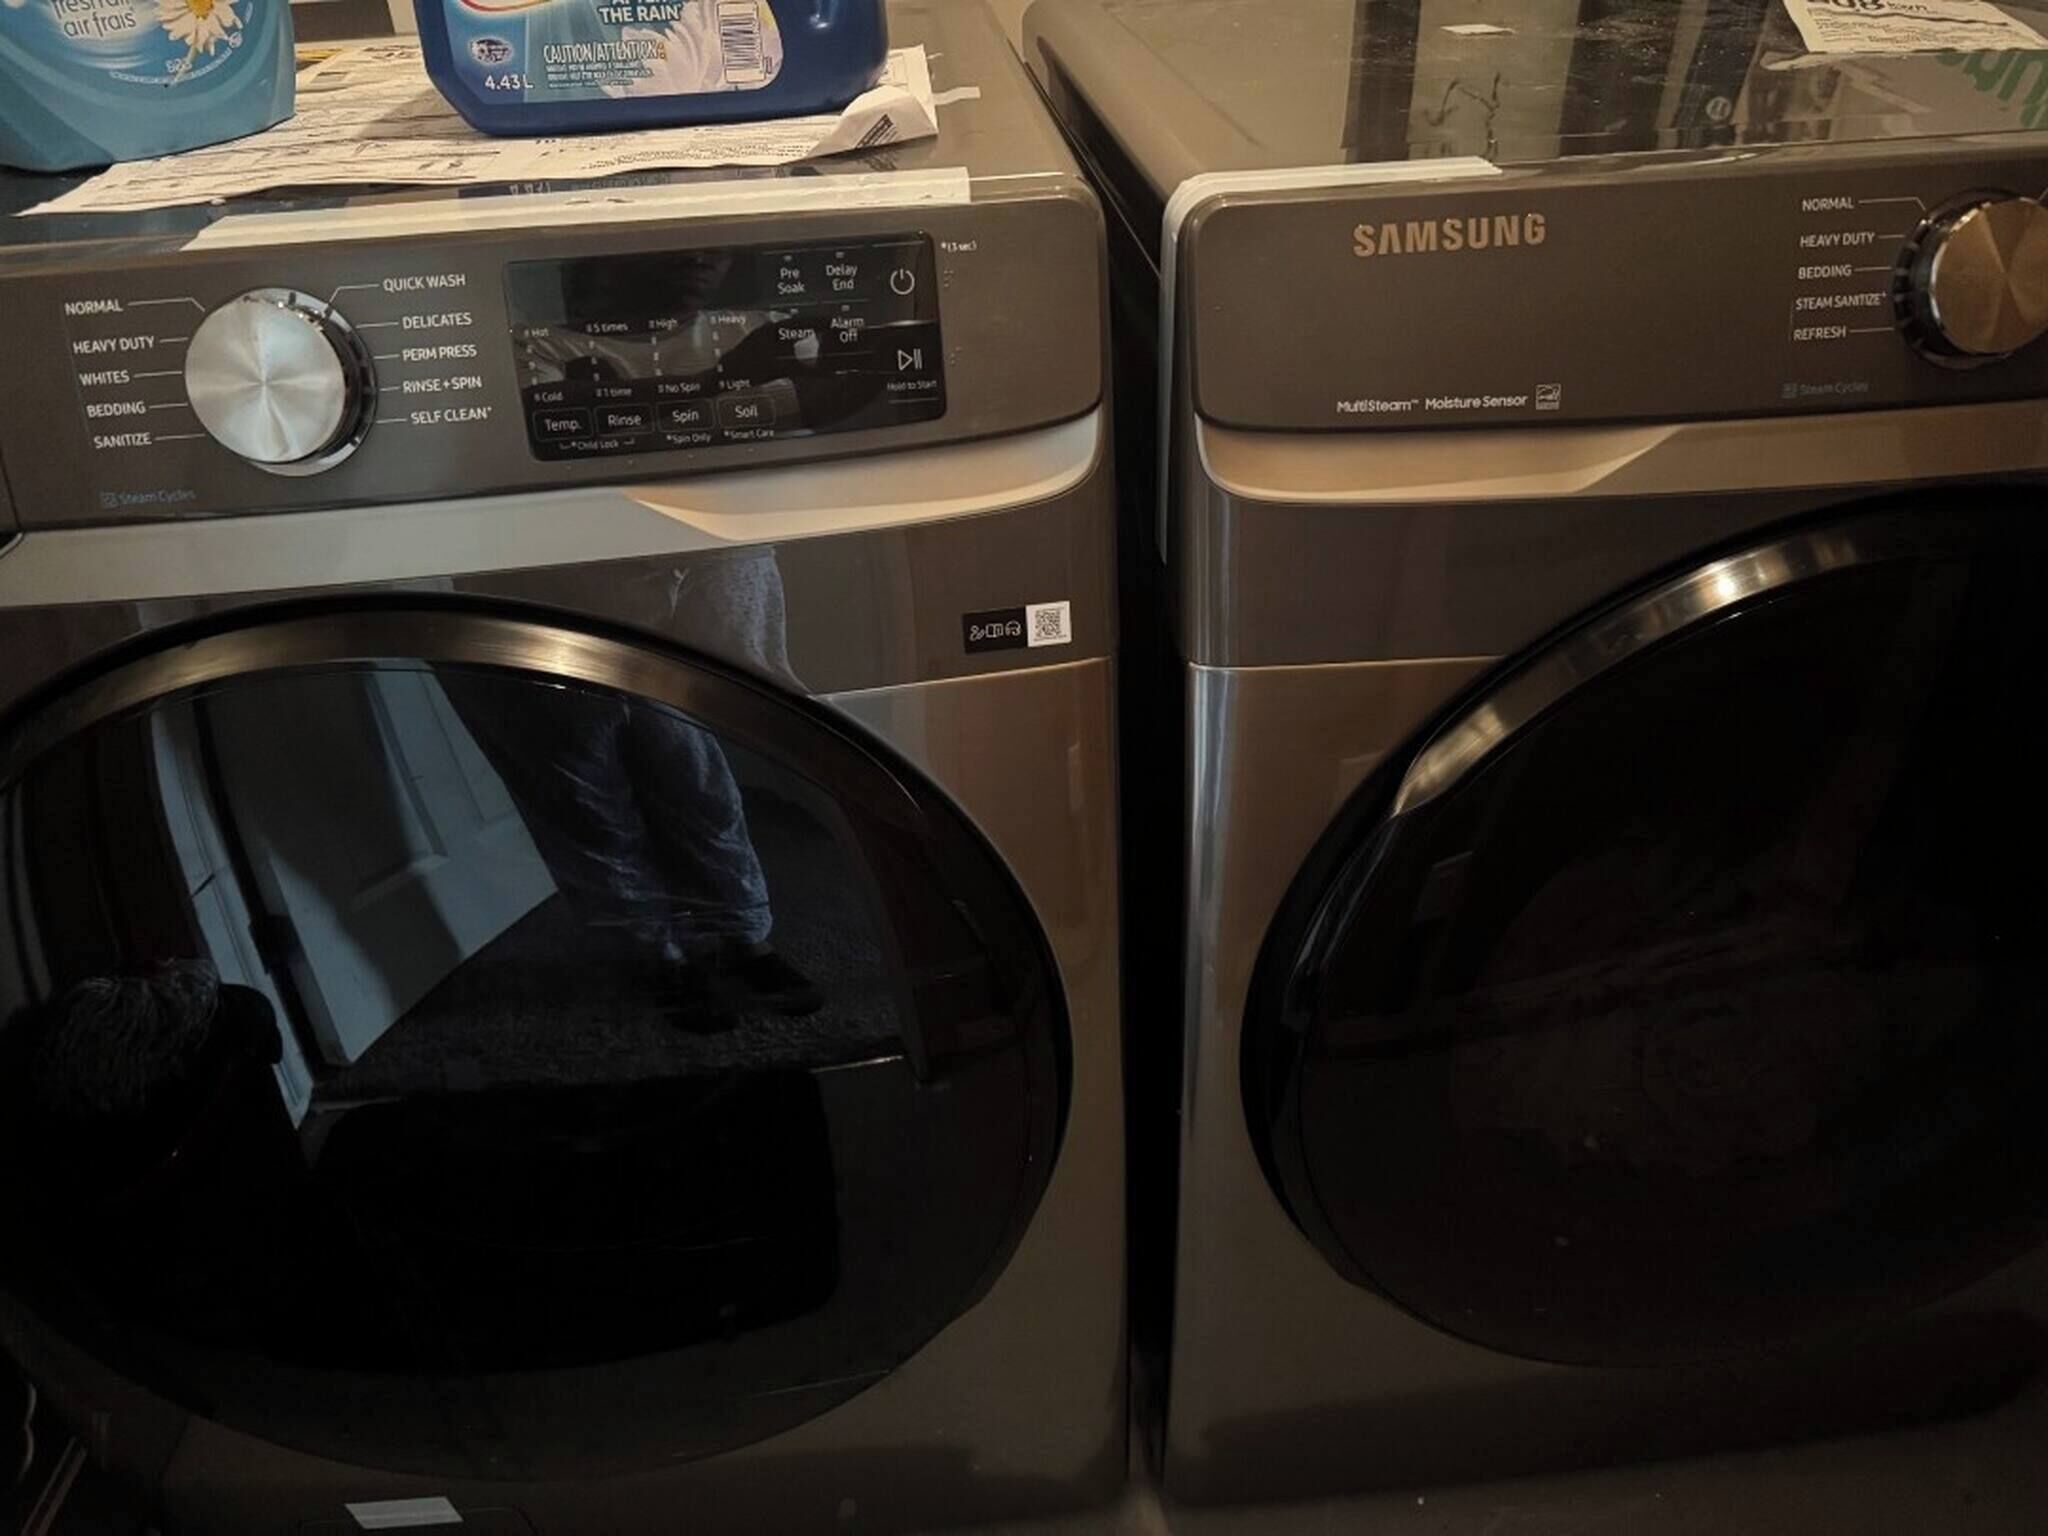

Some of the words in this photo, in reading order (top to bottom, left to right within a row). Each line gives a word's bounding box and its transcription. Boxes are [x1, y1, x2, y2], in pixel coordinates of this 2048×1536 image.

[599, 6, 634, 24] THE
[637, 5, 681, 22] RAIN
[63, 19, 91, 37] air
[92, 11, 137, 37] frais
[485, 74, 521, 90] 4.43
[523, 73, 534, 89] L
[1802, 196, 1855, 212] NORMAL
[1353, 212, 1547, 257] SAMSUNG
[1800, 232, 1841, 249] HEAVY
[1842, 231, 1876, 246] DUTY
[780, 266, 801, 280] Pre
[825, 263, 859, 278] Delay
[1798, 263, 1853, 281] BEDDING
[382, 276, 424, 293] QUICK
[425, 273, 466, 289] WASH
[776, 280, 806, 295] Soak
[831, 278, 855, 292] End
[64, 298, 124, 316] NORMAL
[1795, 295, 1833, 311] STEAM
[401, 311, 473, 330] DELICATES
[656, 317, 678, 331] High
[718, 314, 746, 326] Heavy
[830, 315, 864, 330] Alarm
[777, 327, 815, 341] Steam
[839, 328, 859, 344] Off
[1793, 324, 1847, 341] REFRESH
[72, 337, 118, 354] HEAVY
[119, 335, 154, 351] DUTY
[402, 346, 438, 362] PERM
[438, 343, 478, 359] PRESS
[79, 368, 131, 387] WHITES
[726, 378, 751, 391] Light
[887, 381, 907, 391] Hold
[917, 378, 937, 390] Start
[665, 383, 679, 394] No
[679, 381, 701, 394] Spin
[542, 390, 565, 402] Cold
[1425, 396, 1481, 411] Moisture
[1482, 394, 1529, 408] Sensor
[86, 400, 147, 419] BEDDING
[410, 409, 442, 425] SELF
[671, 408, 701, 424] Spin
[734, 404, 760, 420] Soil
[544, 417, 582, 433] Temp.
[606, 413, 642, 428] Rinse
[93, 432, 153, 450] SANITIZE
